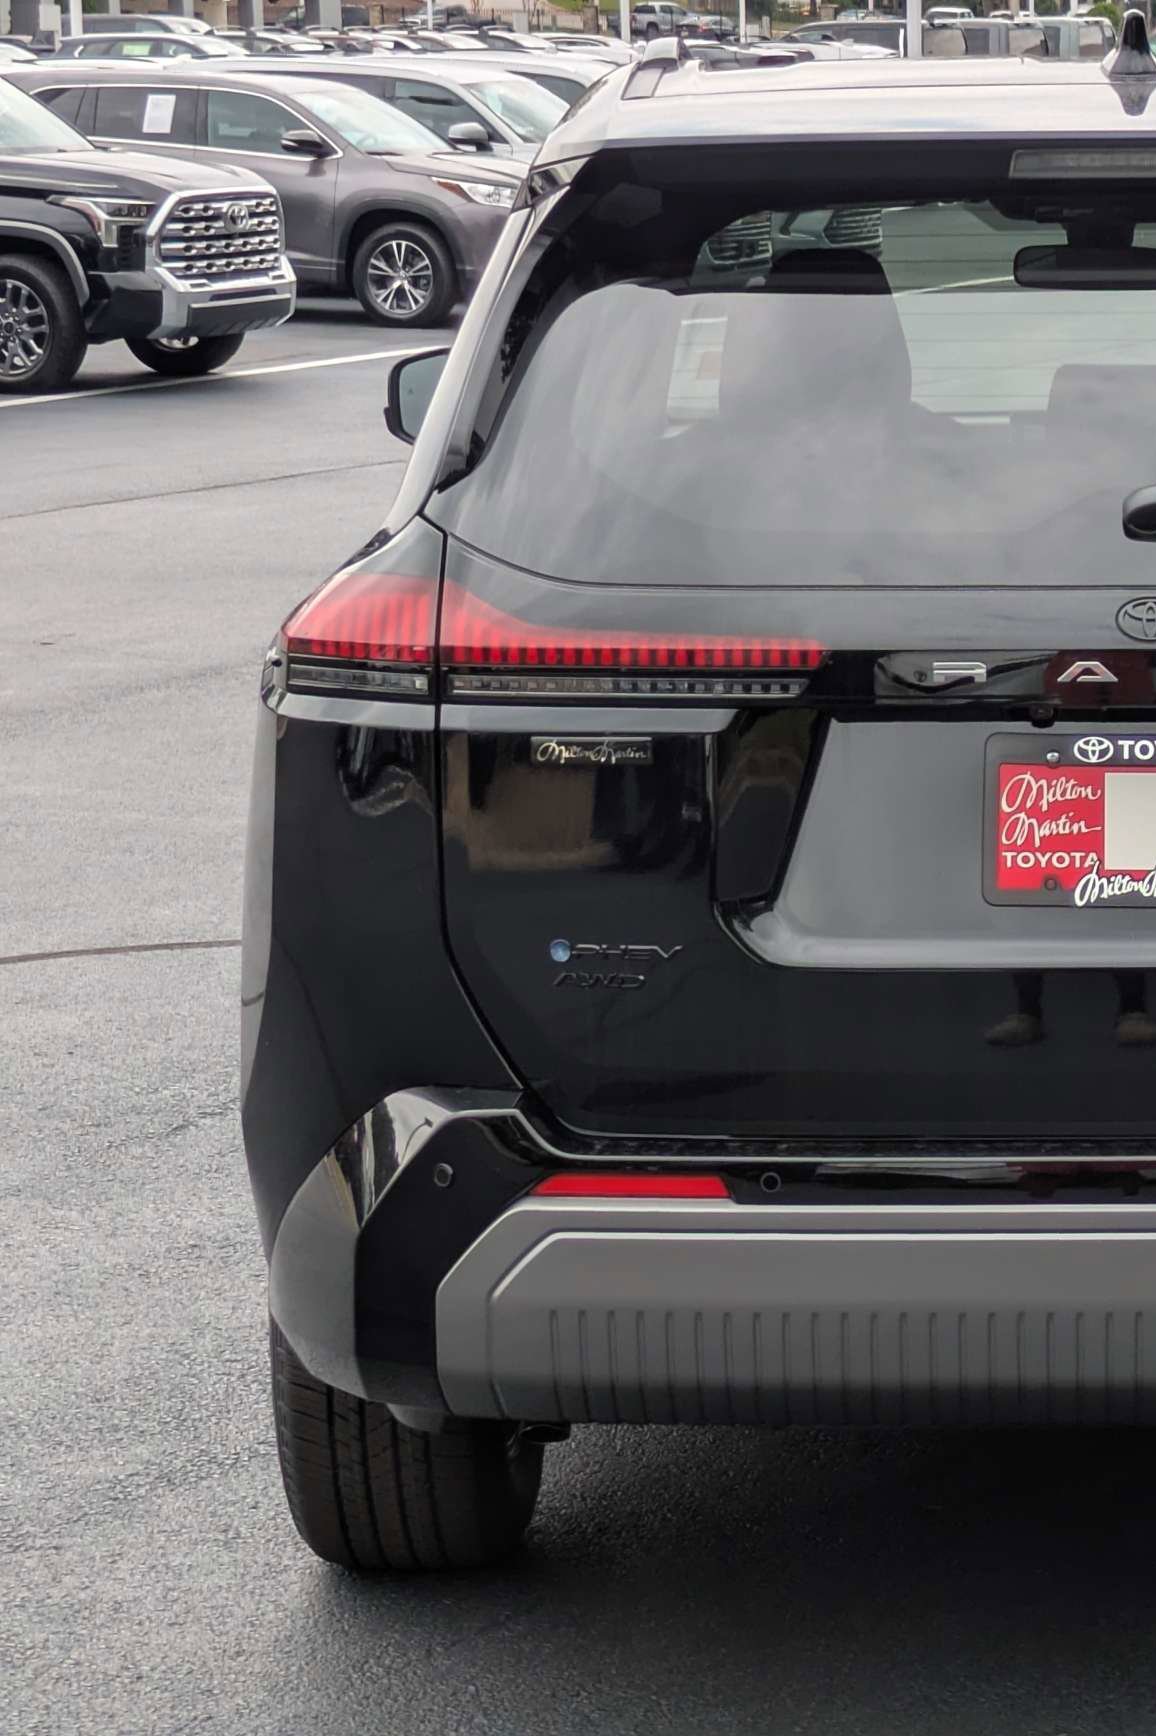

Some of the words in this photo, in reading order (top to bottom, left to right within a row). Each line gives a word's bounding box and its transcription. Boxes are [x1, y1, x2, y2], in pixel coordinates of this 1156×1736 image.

[537, 738, 592, 764] Milton
[590, 739, 647, 764] Martin
[1001, 772, 1101, 813] Milton
[1001, 812, 1102, 848] Martin
[1002, 851, 1100, 869] TOYOTA
[1074, 860, 1150, 907] Milton
[571, 943, 683, 960] PHEV
[553, 971, 646, 989] AWD
